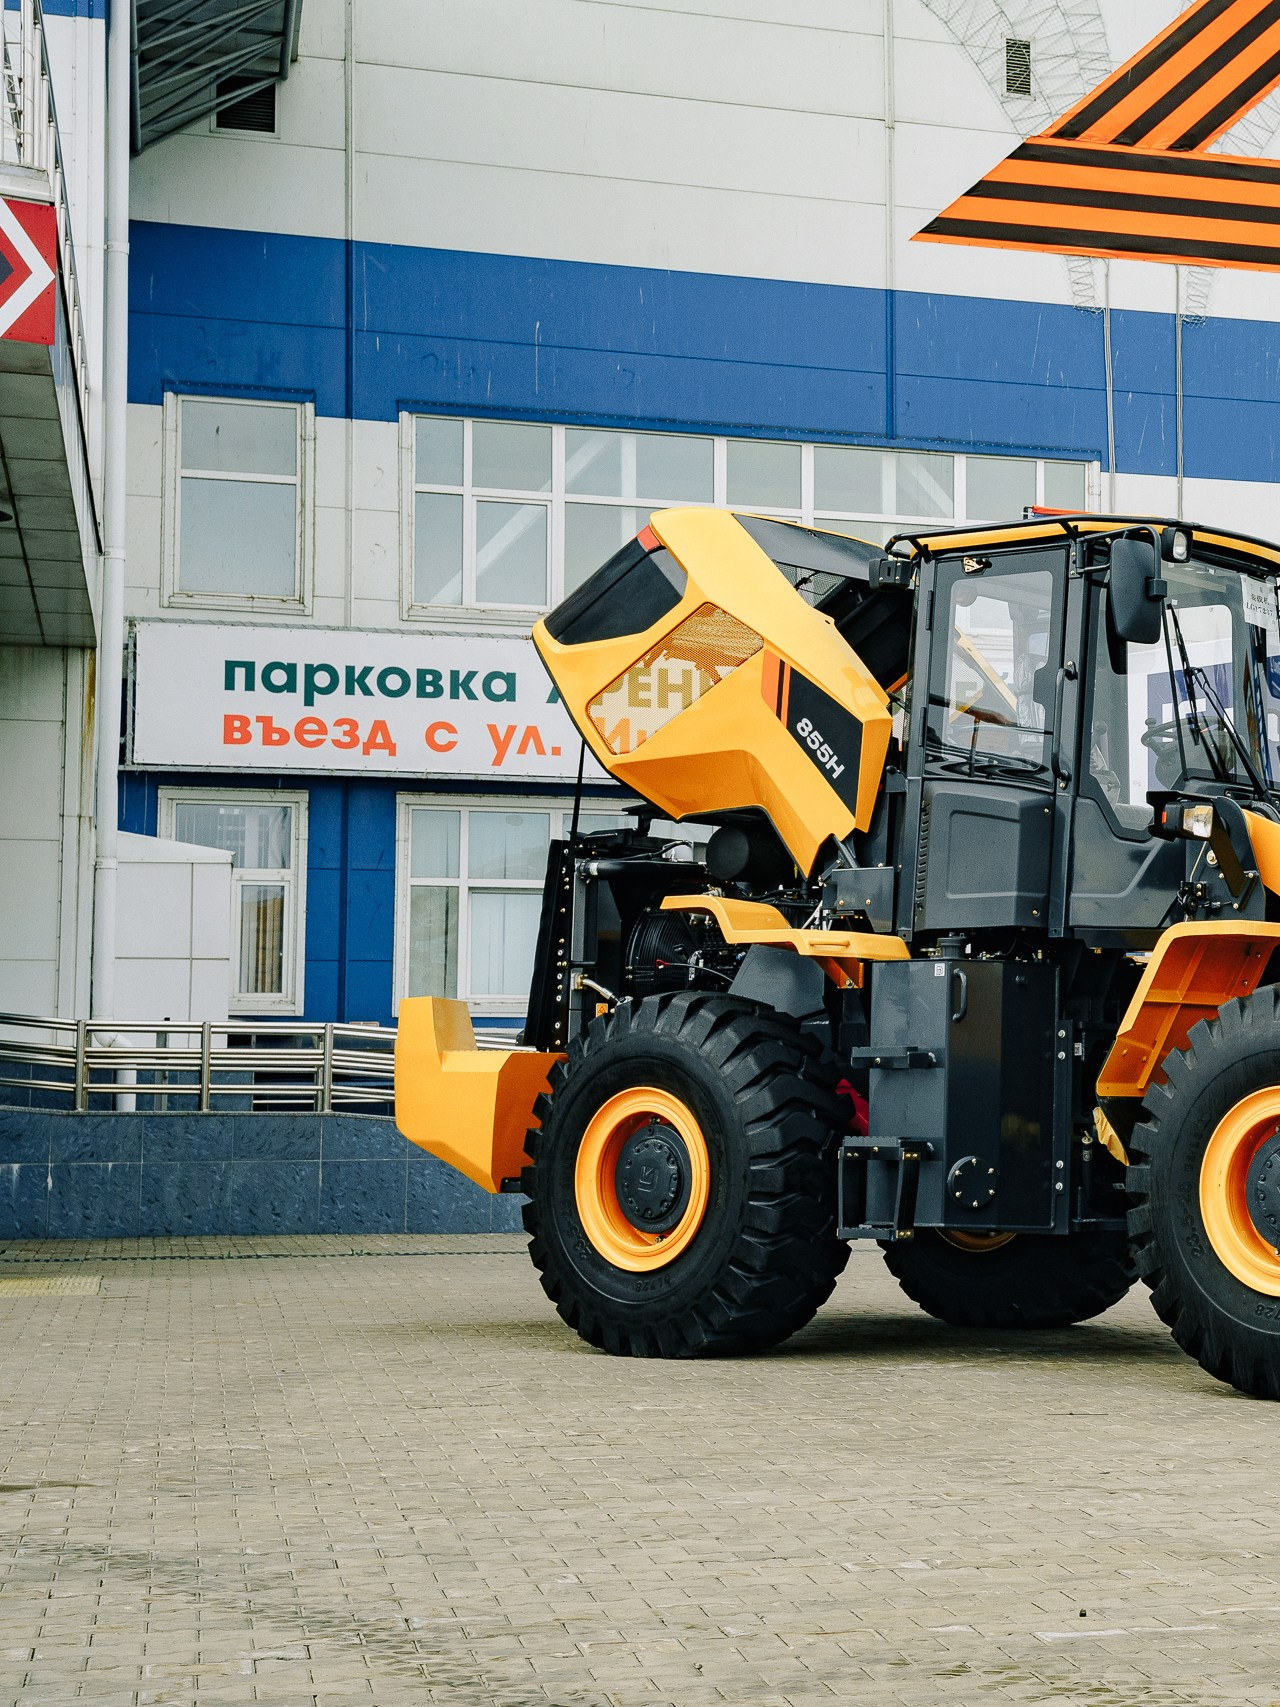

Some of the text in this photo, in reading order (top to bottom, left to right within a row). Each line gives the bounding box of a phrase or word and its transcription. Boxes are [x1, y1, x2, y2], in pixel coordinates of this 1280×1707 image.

[224, 659, 517, 707] парковка
[222, 714, 397, 757] въезд
[424, 721, 459, 753] с
[486, 723, 562, 767] ул.
[796, 717, 845, 780] 855H
